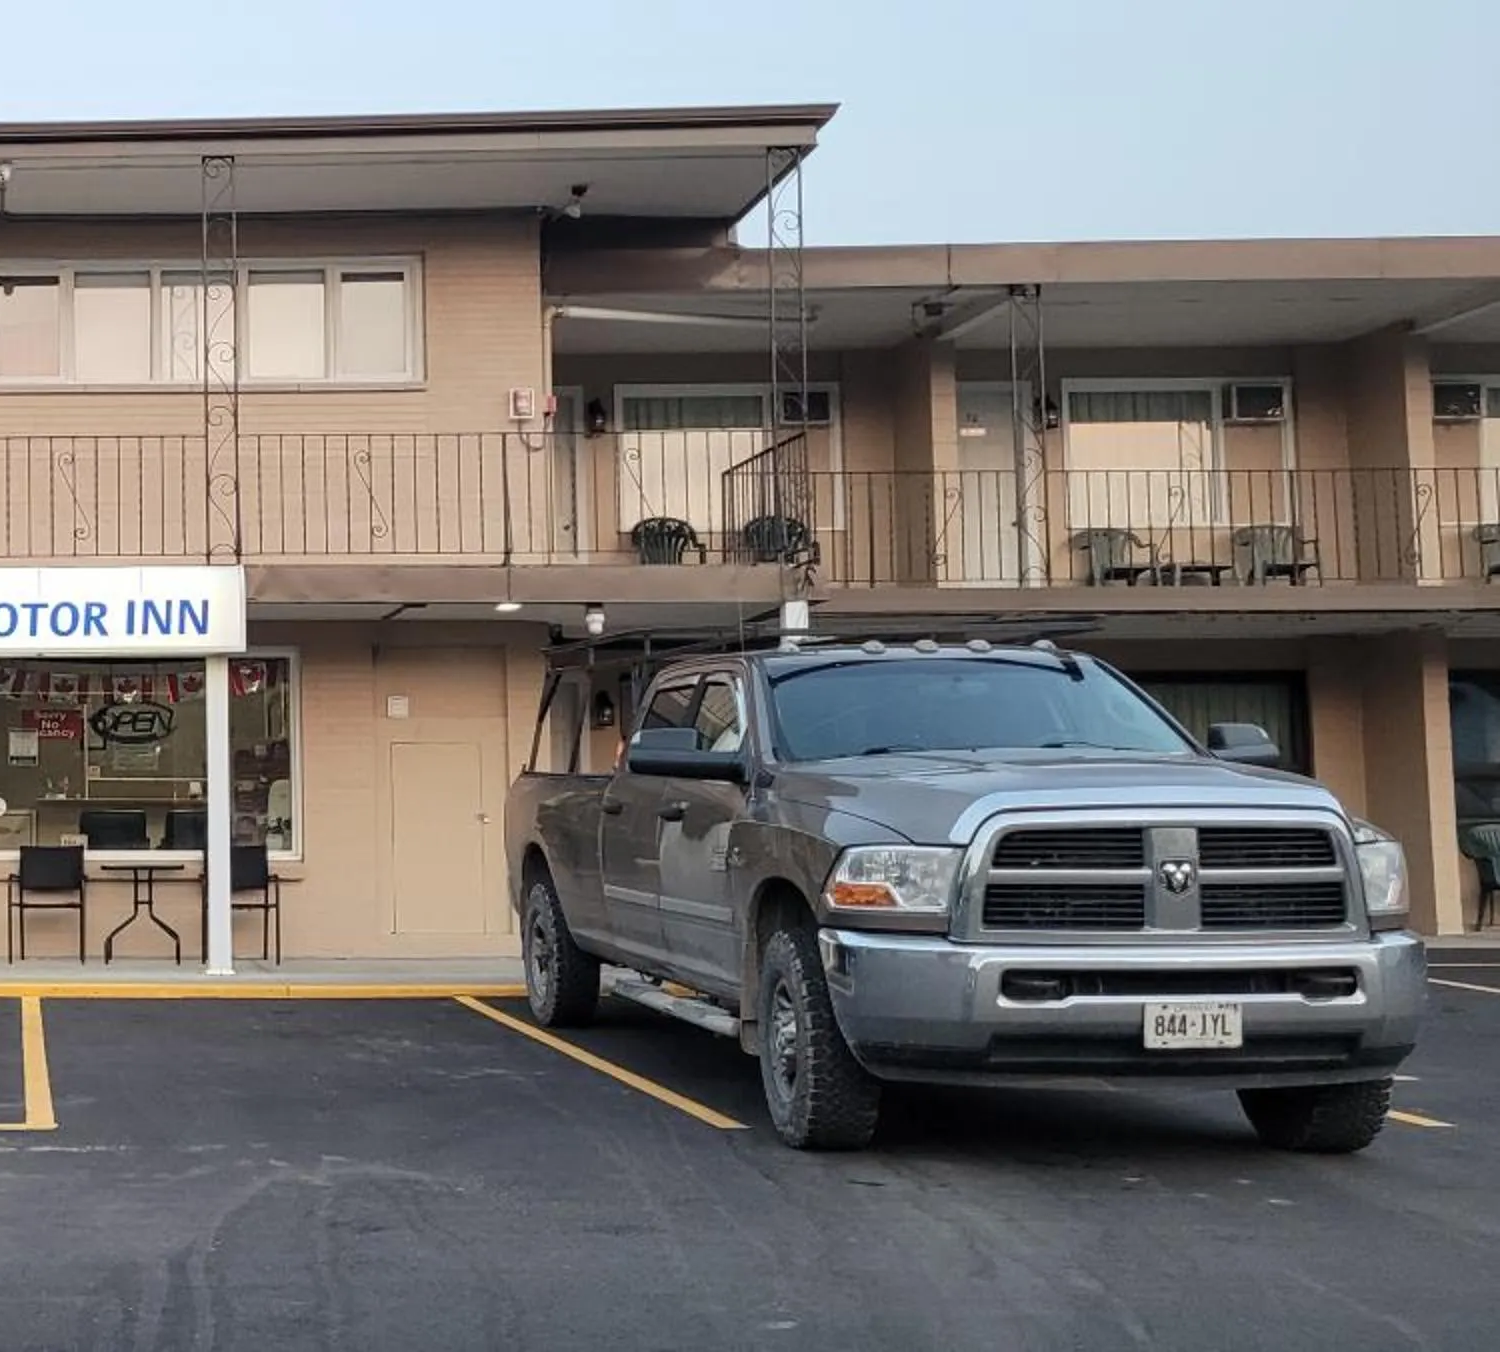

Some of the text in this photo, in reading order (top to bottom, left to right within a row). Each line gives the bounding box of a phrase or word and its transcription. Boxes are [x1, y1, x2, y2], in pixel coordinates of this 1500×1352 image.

[125, 599, 209, 636] INN
[41, 719, 60, 729] No
[102, 710, 173, 733] OPEN
[39, 729, 75, 739] cancy
